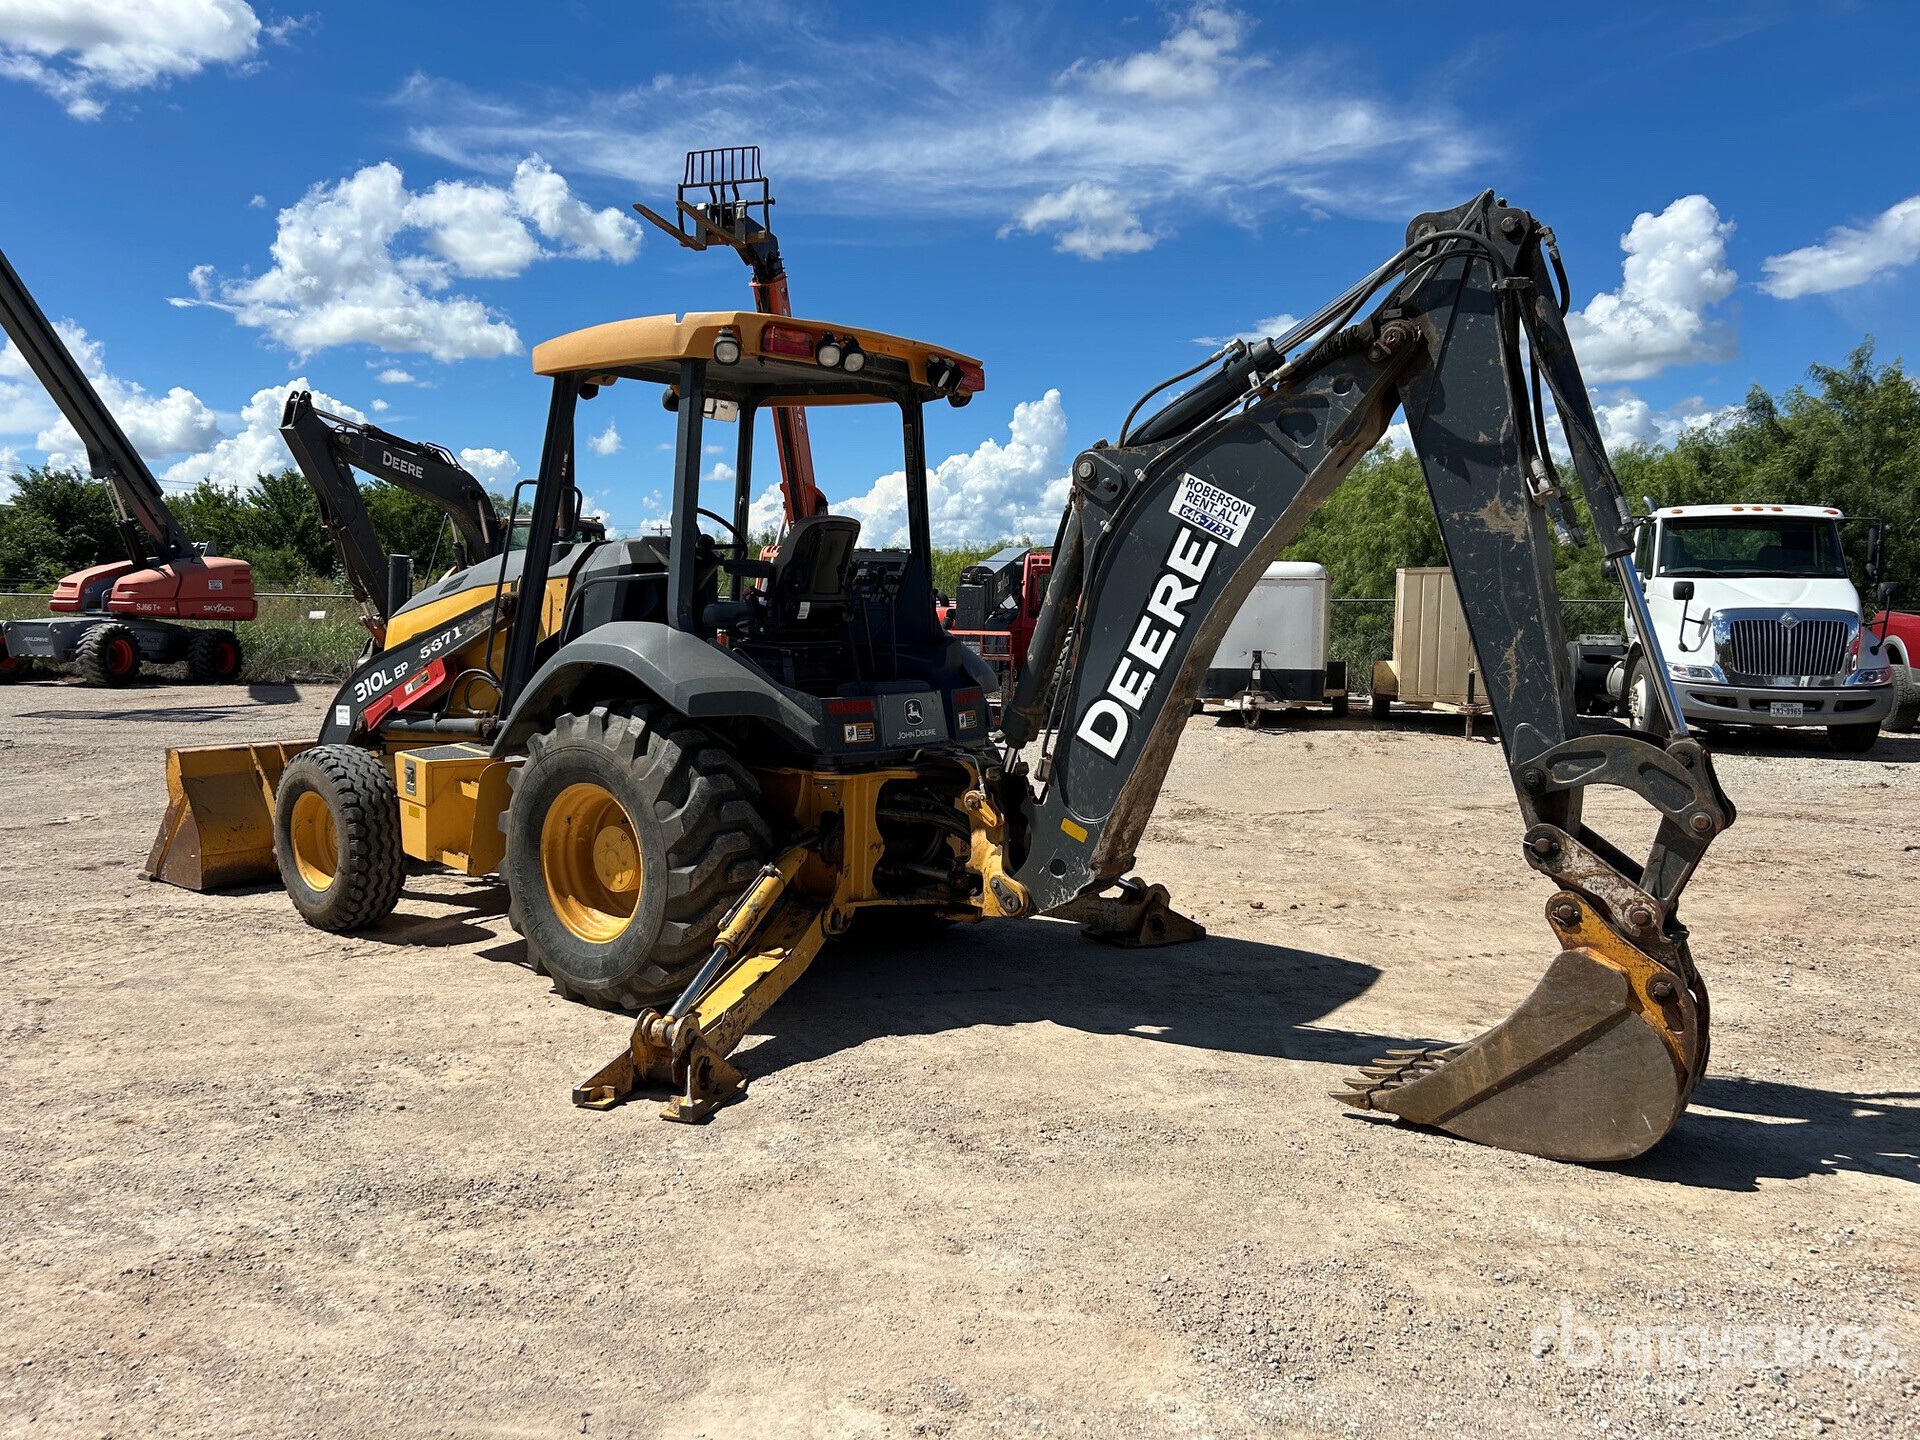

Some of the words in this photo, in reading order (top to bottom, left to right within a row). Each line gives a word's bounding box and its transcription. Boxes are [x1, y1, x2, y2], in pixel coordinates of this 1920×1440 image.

[382, 450, 424, 479] DEERE
[1184, 490, 1239, 527] RENT-ALL
[1185, 477, 1251, 517] ROBERSON
[1181, 506, 1231, 539] 646-7732
[203, 603, 235, 613] SKYJACK
[1076, 526, 1218, 760] DEERE
[353, 669, 393, 703] 310L
[393, 661, 409, 680] EP
[897, 731, 915, 740] JOHN
[915, 728, 937, 738] DEERE
